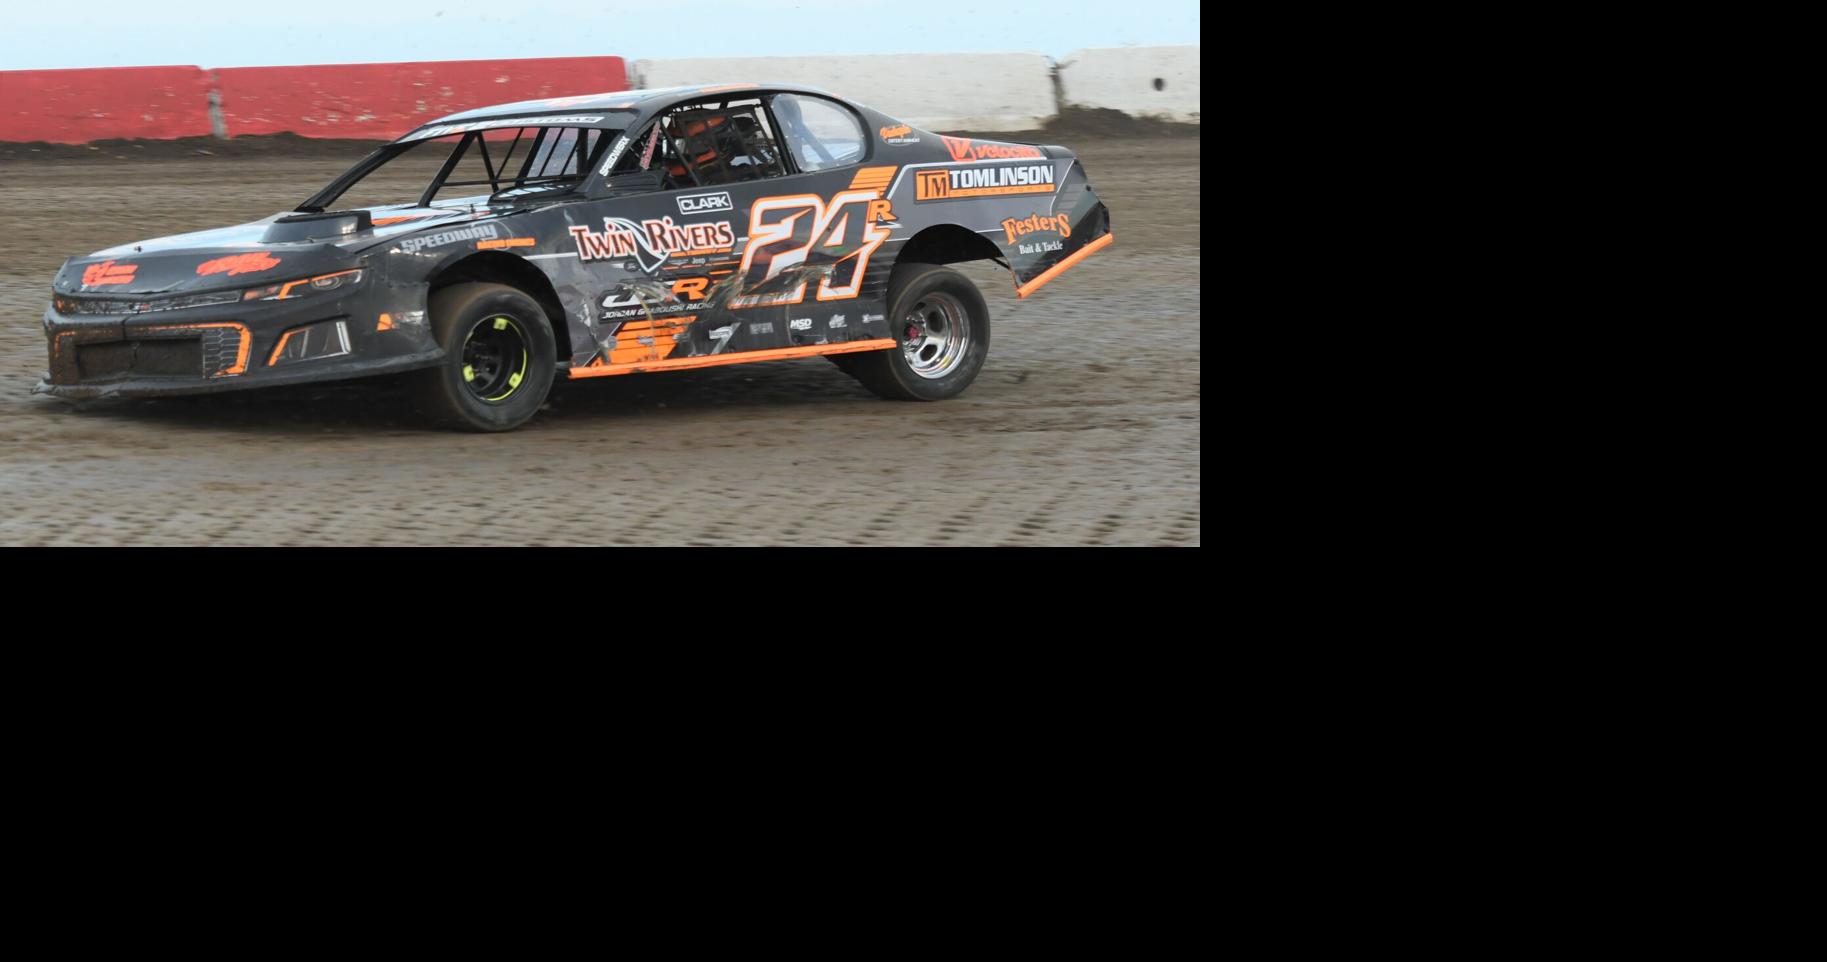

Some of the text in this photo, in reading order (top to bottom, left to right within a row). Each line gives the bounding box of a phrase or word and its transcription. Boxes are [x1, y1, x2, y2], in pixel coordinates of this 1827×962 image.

[949, 165, 1053, 189] TOMLINSON
[680, 195, 729, 211] CLARK
[401, 223, 498, 254] SPEEDWAY
[1018, 243, 1034, 255] Bait
[1035, 242, 1042, 252] &
[728, 189, 891, 310] 24
[790, 318, 812, 330] MSD
